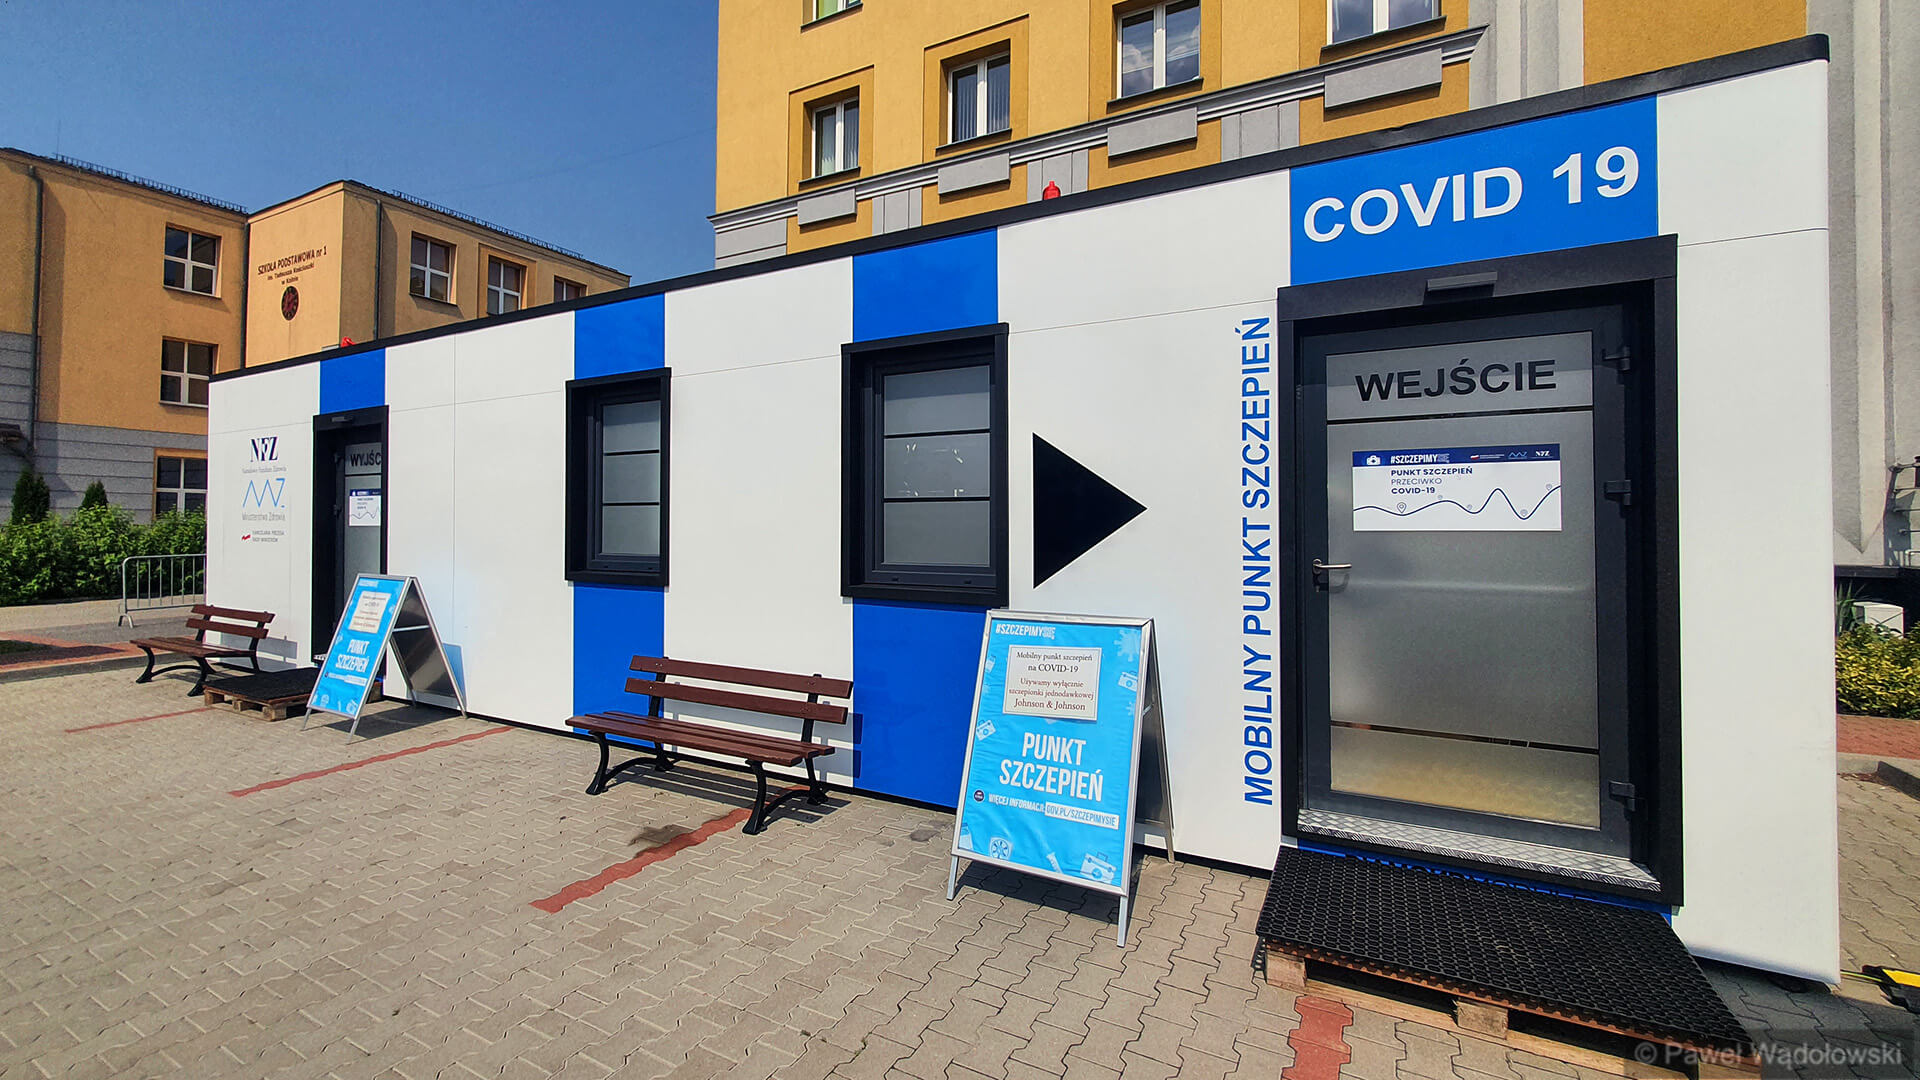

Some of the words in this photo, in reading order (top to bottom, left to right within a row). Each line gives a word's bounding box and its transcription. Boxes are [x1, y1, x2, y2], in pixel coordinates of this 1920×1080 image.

[1303, 166, 1523, 242] COVID
[1552, 146, 1640, 205] 19
[277, 249, 315, 268] PODSTAWOWA
[316, 249, 322, 257] nr
[1355, 358, 1557, 402] WEJŚCIE
[1233, 317, 1270, 509] SZCZEPIEŃ
[250, 436, 279, 462] NFZ
[1423, 466, 1473, 475] SZCZEPIEŃ
[1391, 478, 1442, 486] PRZECIWKO
[1242, 517, 1271, 636] PUNKT
[346, 639, 370, 655] PUNKT
[335, 655, 370, 673] SZCZEPIEŃ
[1016, 652, 1041, 661] Mobilny
[1043, 653, 1061, 661] punkt
[1063, 654, 1092, 662] szczepień
[1038, 664, 1079, 673] COVID-19
[1052, 680, 1084, 688] wyłącznie
[1009, 688, 1043, 697] szczepionki
[1044, 689, 1094, 700] jednodawkowej
[1014, 698, 1044, 708] Johnson
[1046, 700, 1053, 708] &
[1054, 701, 1086, 710] Johnson
[1243, 644, 1272, 806] MOBILNY
[1022, 732, 1087, 766] PUNKT
[999, 759, 1103, 802] SZCZEPIEŃ
[988, 793, 1009, 806] WIĘCEJ
[1046, 804, 1116, 827] GOV.PL/SZCZEPIMYSIE
